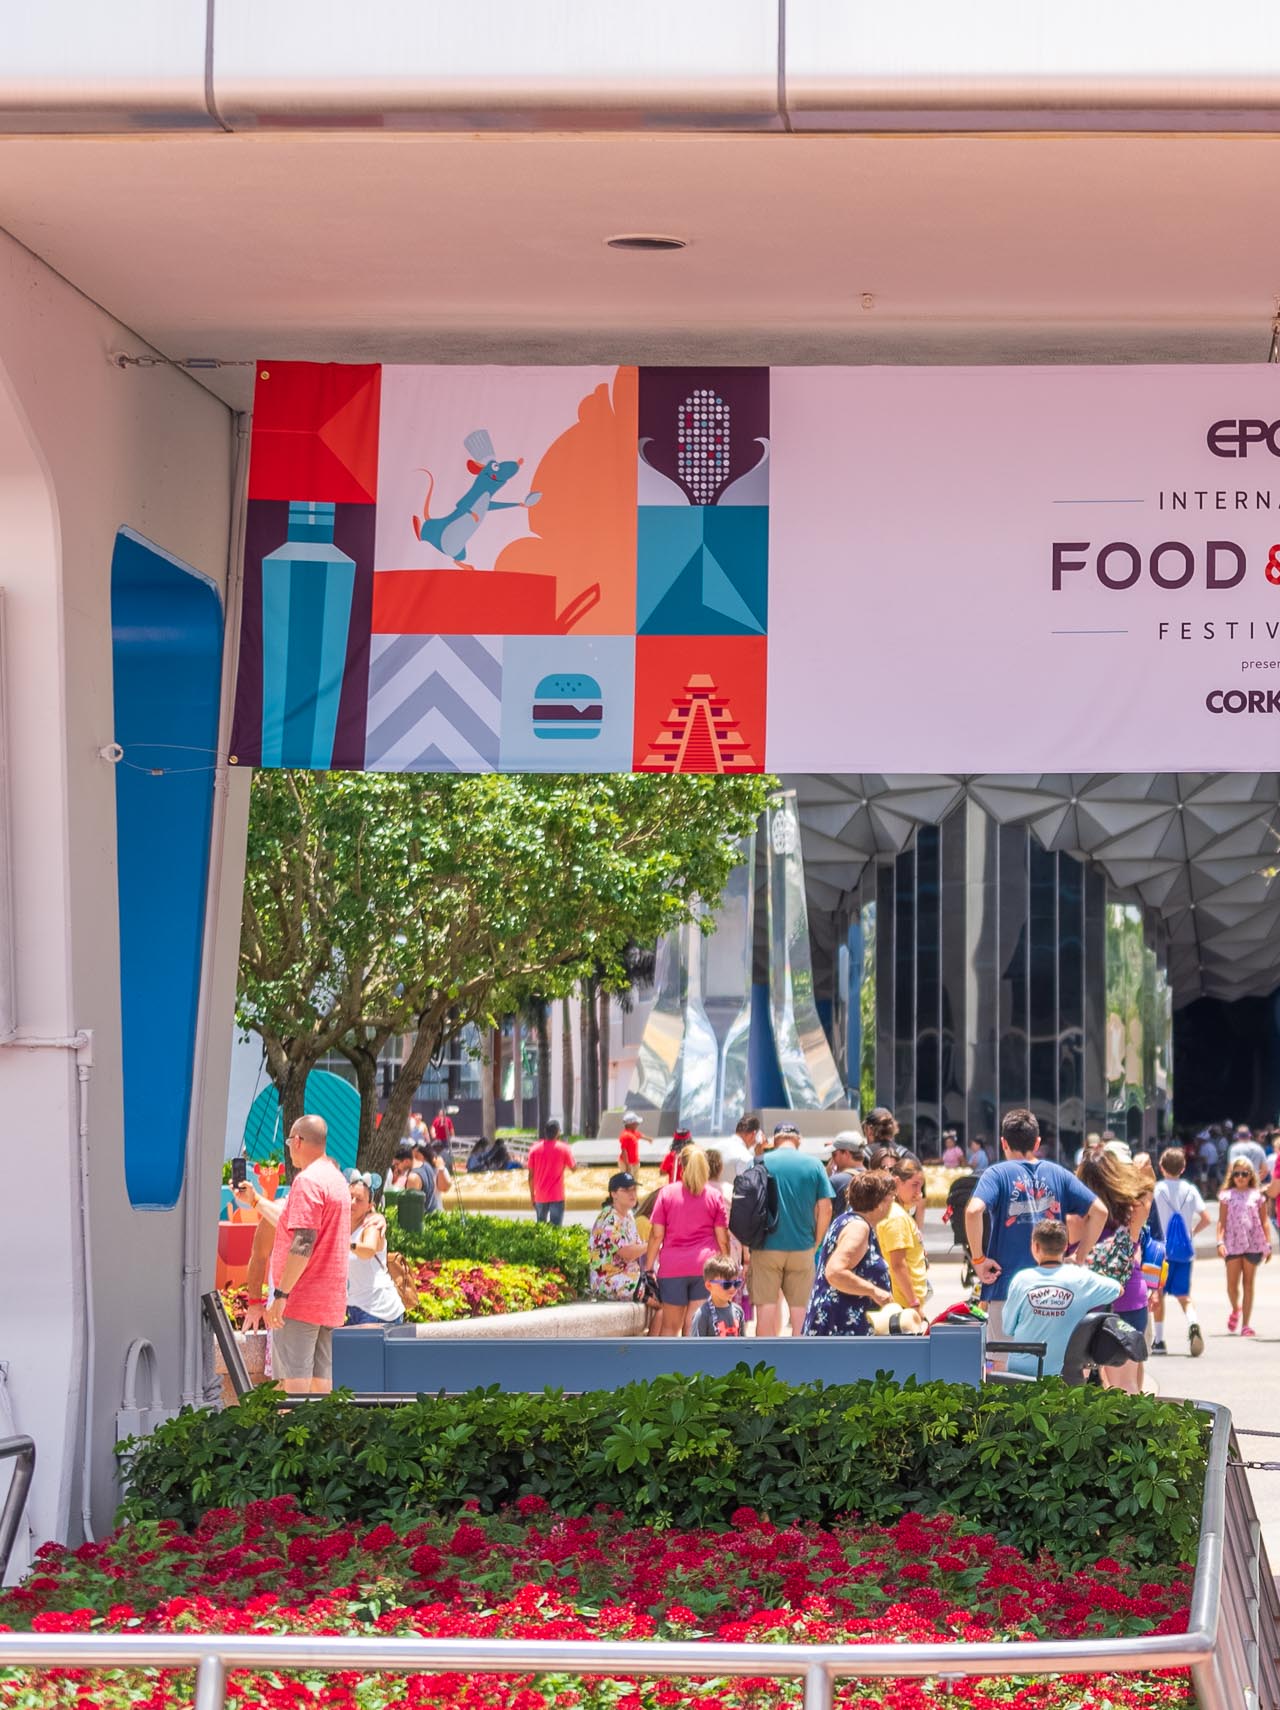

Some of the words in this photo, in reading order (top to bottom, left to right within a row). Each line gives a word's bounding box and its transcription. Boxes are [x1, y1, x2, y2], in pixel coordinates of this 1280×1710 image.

[1051, 540, 1247, 592] FOOD
[1030, 1288, 1050, 1300] RON
[1052, 1289, 1072, 1301] JON
[1033, 1309, 1066, 1317] ORLANDO
